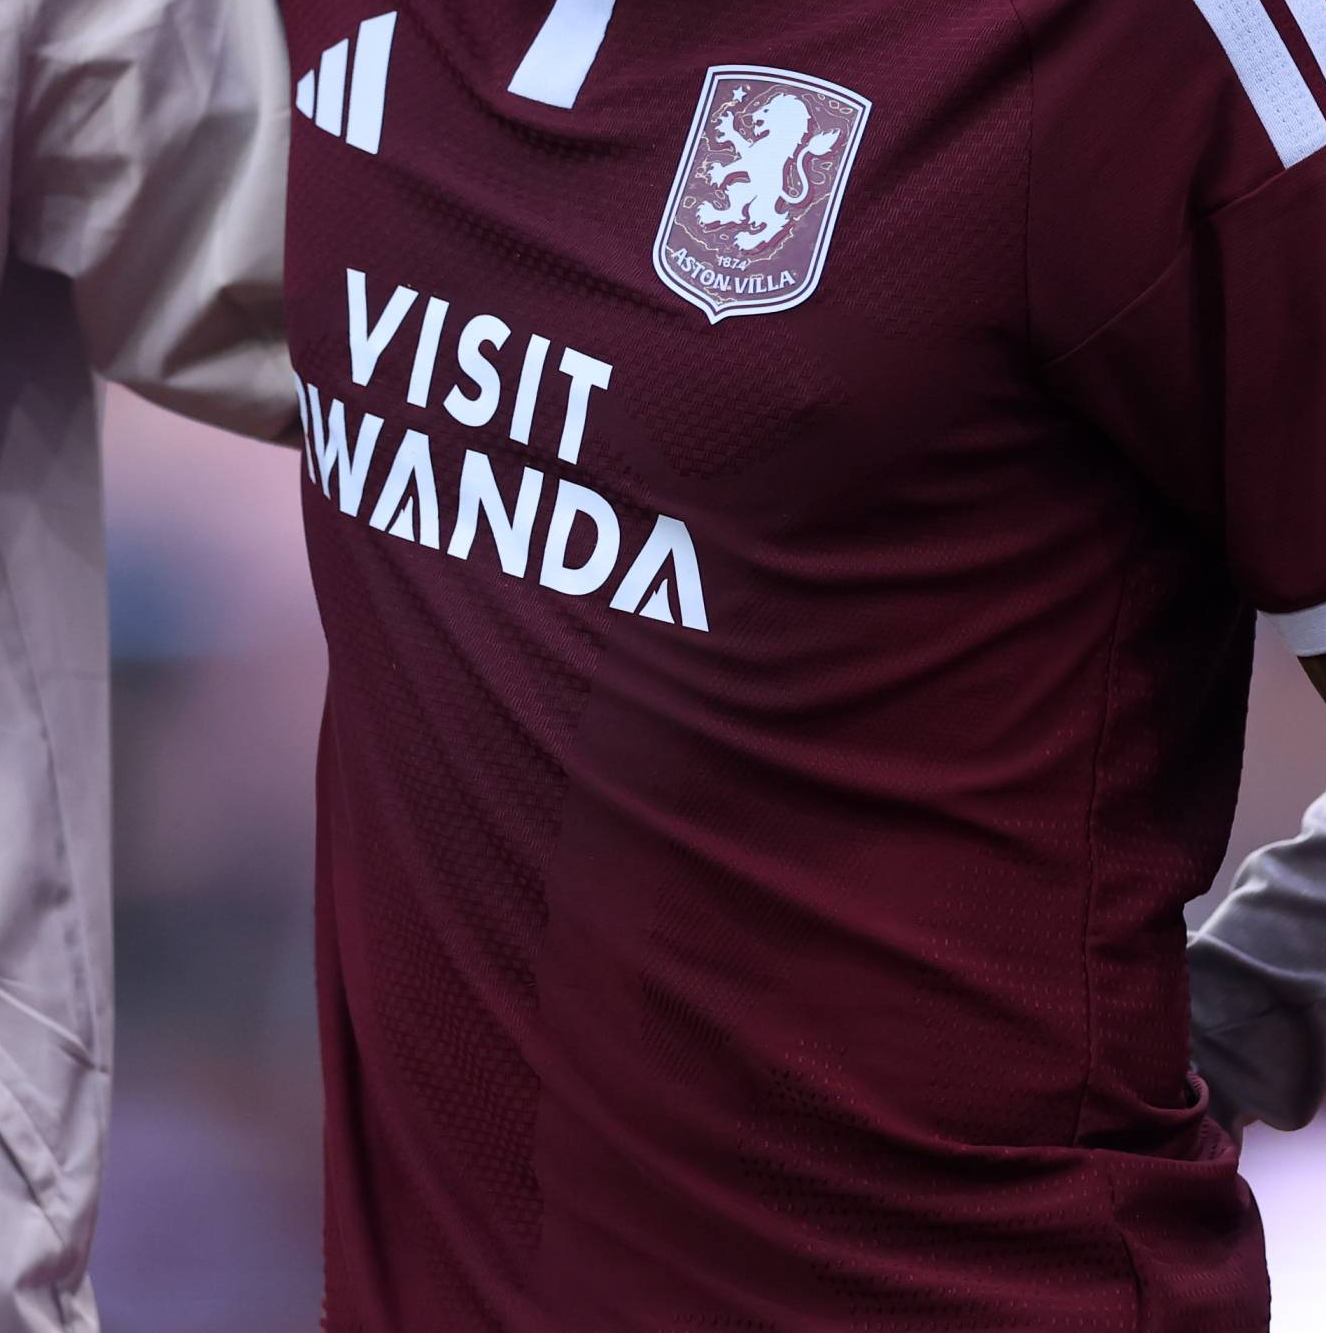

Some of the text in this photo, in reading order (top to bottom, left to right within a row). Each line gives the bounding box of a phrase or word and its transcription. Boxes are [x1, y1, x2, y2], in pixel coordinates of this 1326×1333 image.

[673, 248, 796, 294] ASTON VILLA
[718, 256, 749, 271] 1874
[346, 268, 613, 465] VISIT
[294, 369, 710, 633] WANDA
